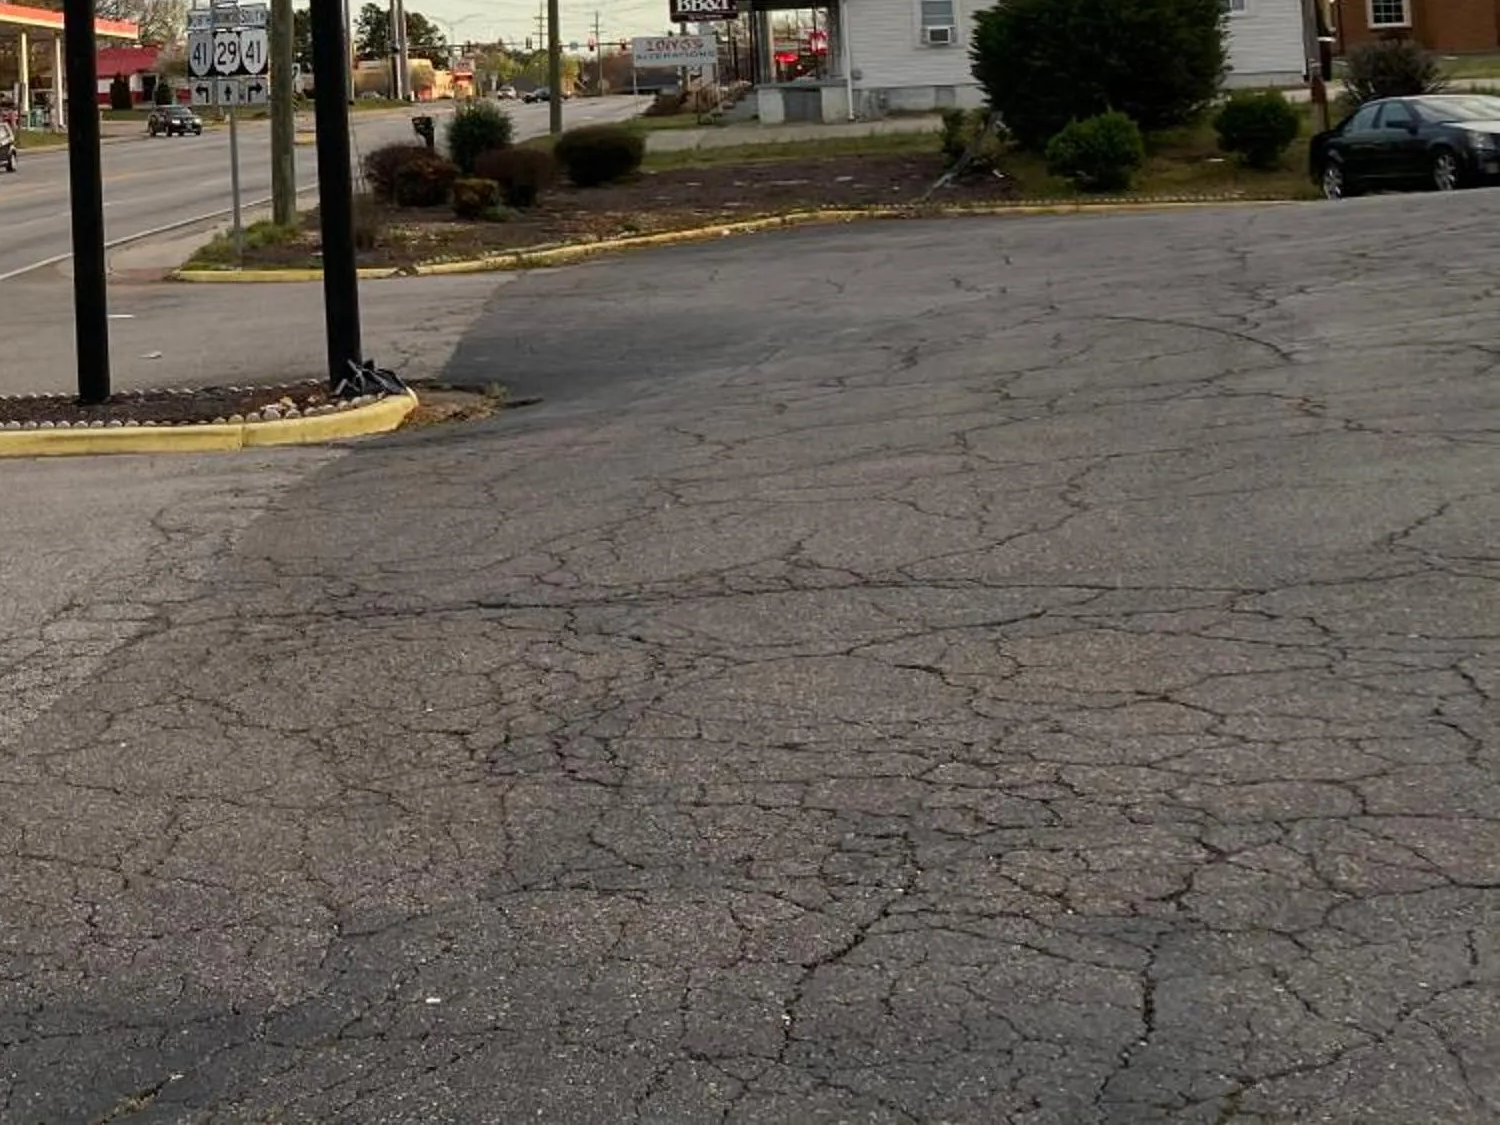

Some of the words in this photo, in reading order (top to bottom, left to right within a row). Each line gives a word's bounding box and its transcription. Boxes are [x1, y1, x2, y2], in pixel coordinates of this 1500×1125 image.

[193, 42, 207, 65] 41
[217, 41, 237, 65] 29
[245, 40, 261, 63] 41
